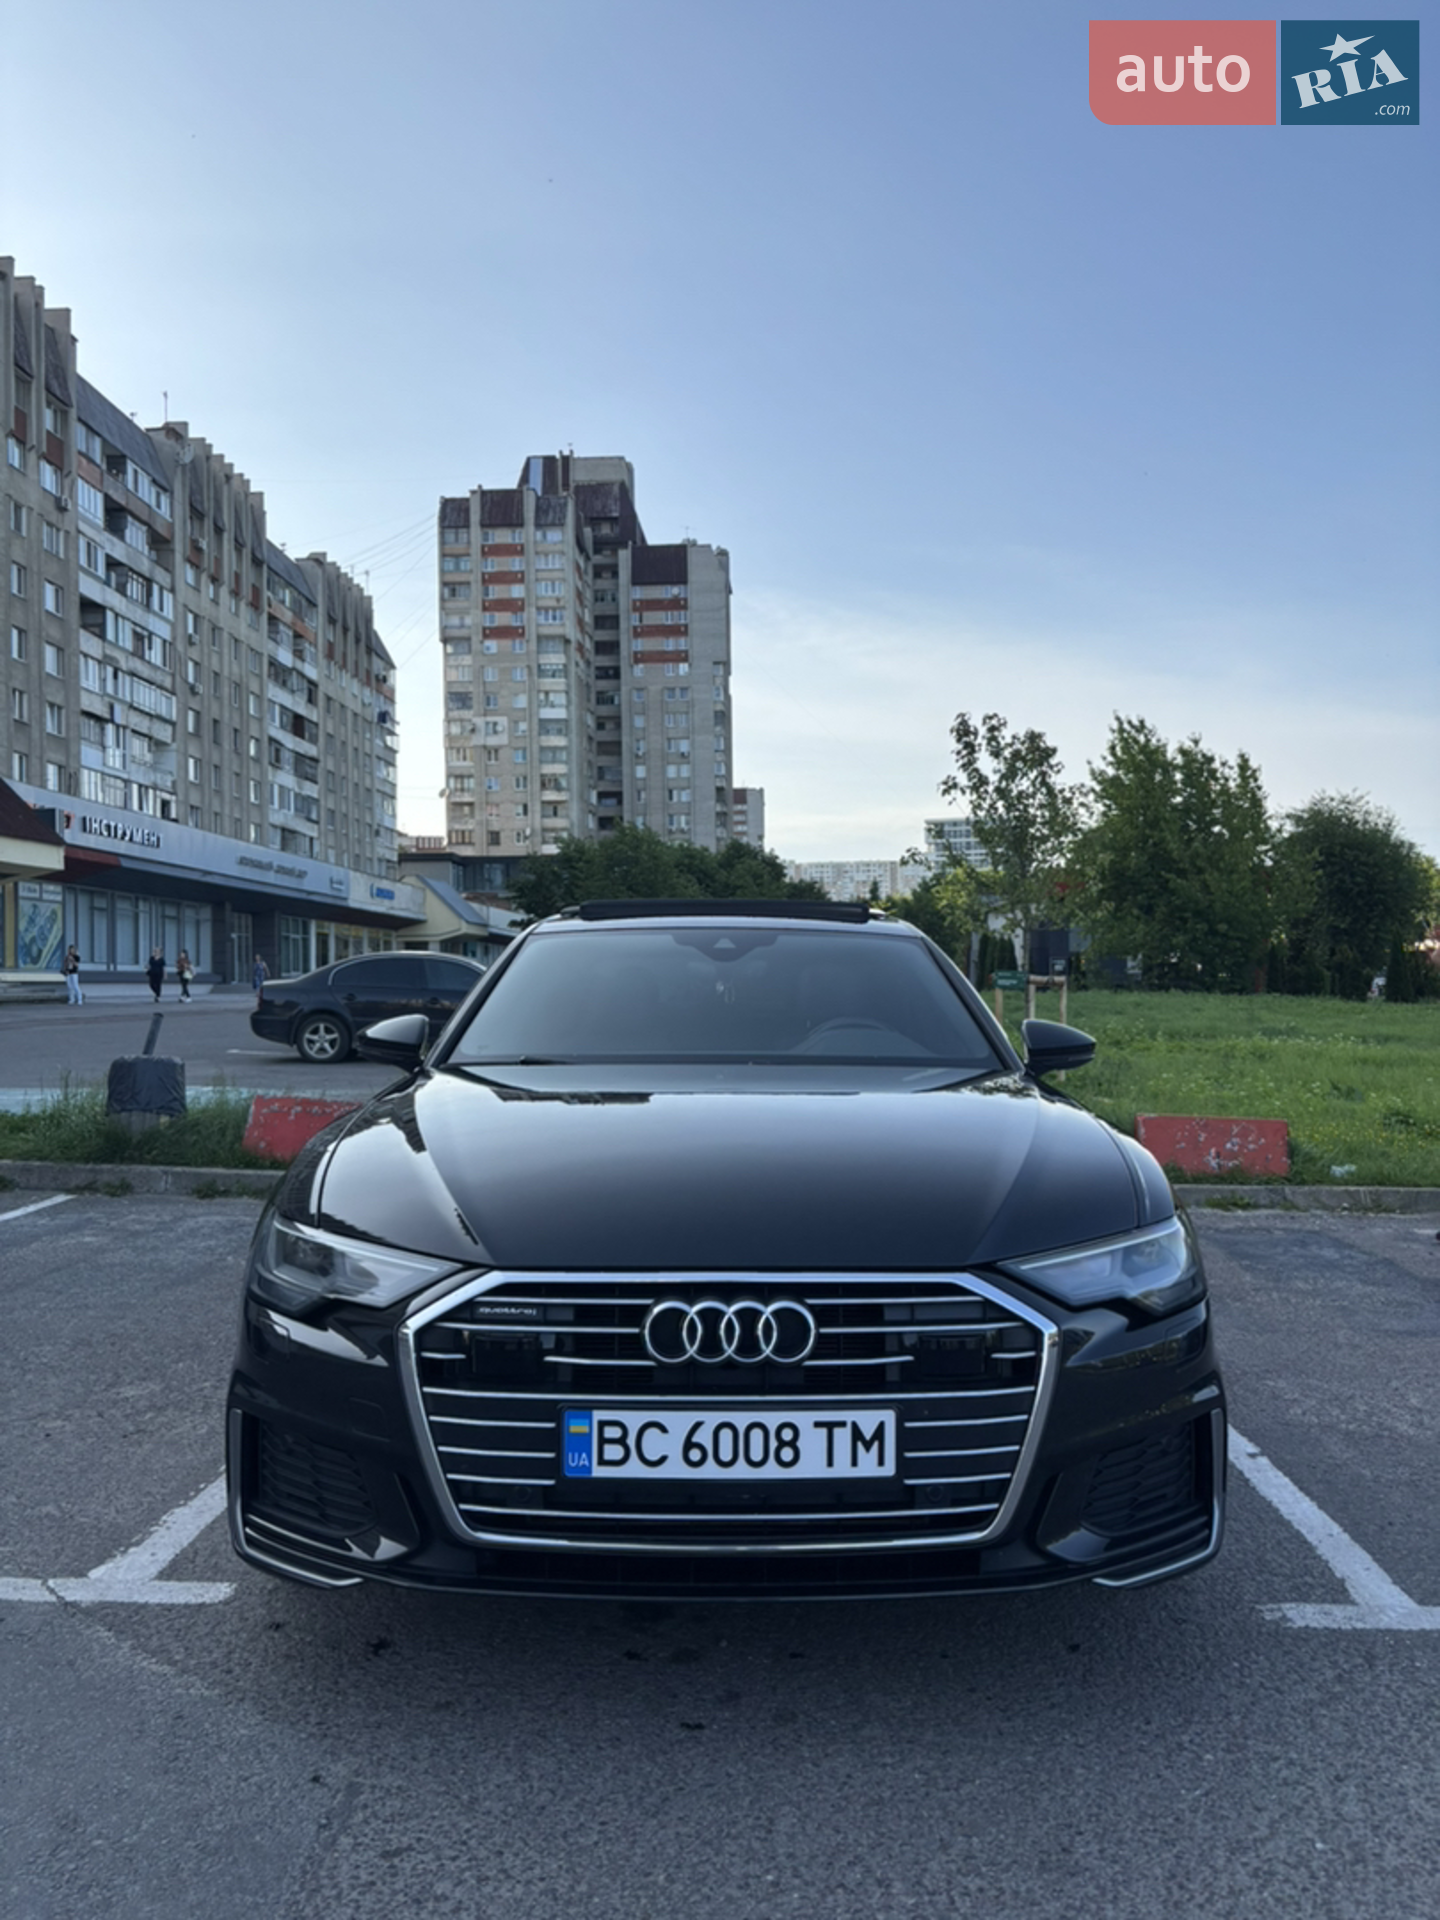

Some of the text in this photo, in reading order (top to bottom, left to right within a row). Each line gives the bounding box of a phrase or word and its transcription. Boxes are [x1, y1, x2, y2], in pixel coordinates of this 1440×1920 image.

[568, 1452, 590, 1467] UA
[597, 1418, 886, 1469] BC 6008 TM
